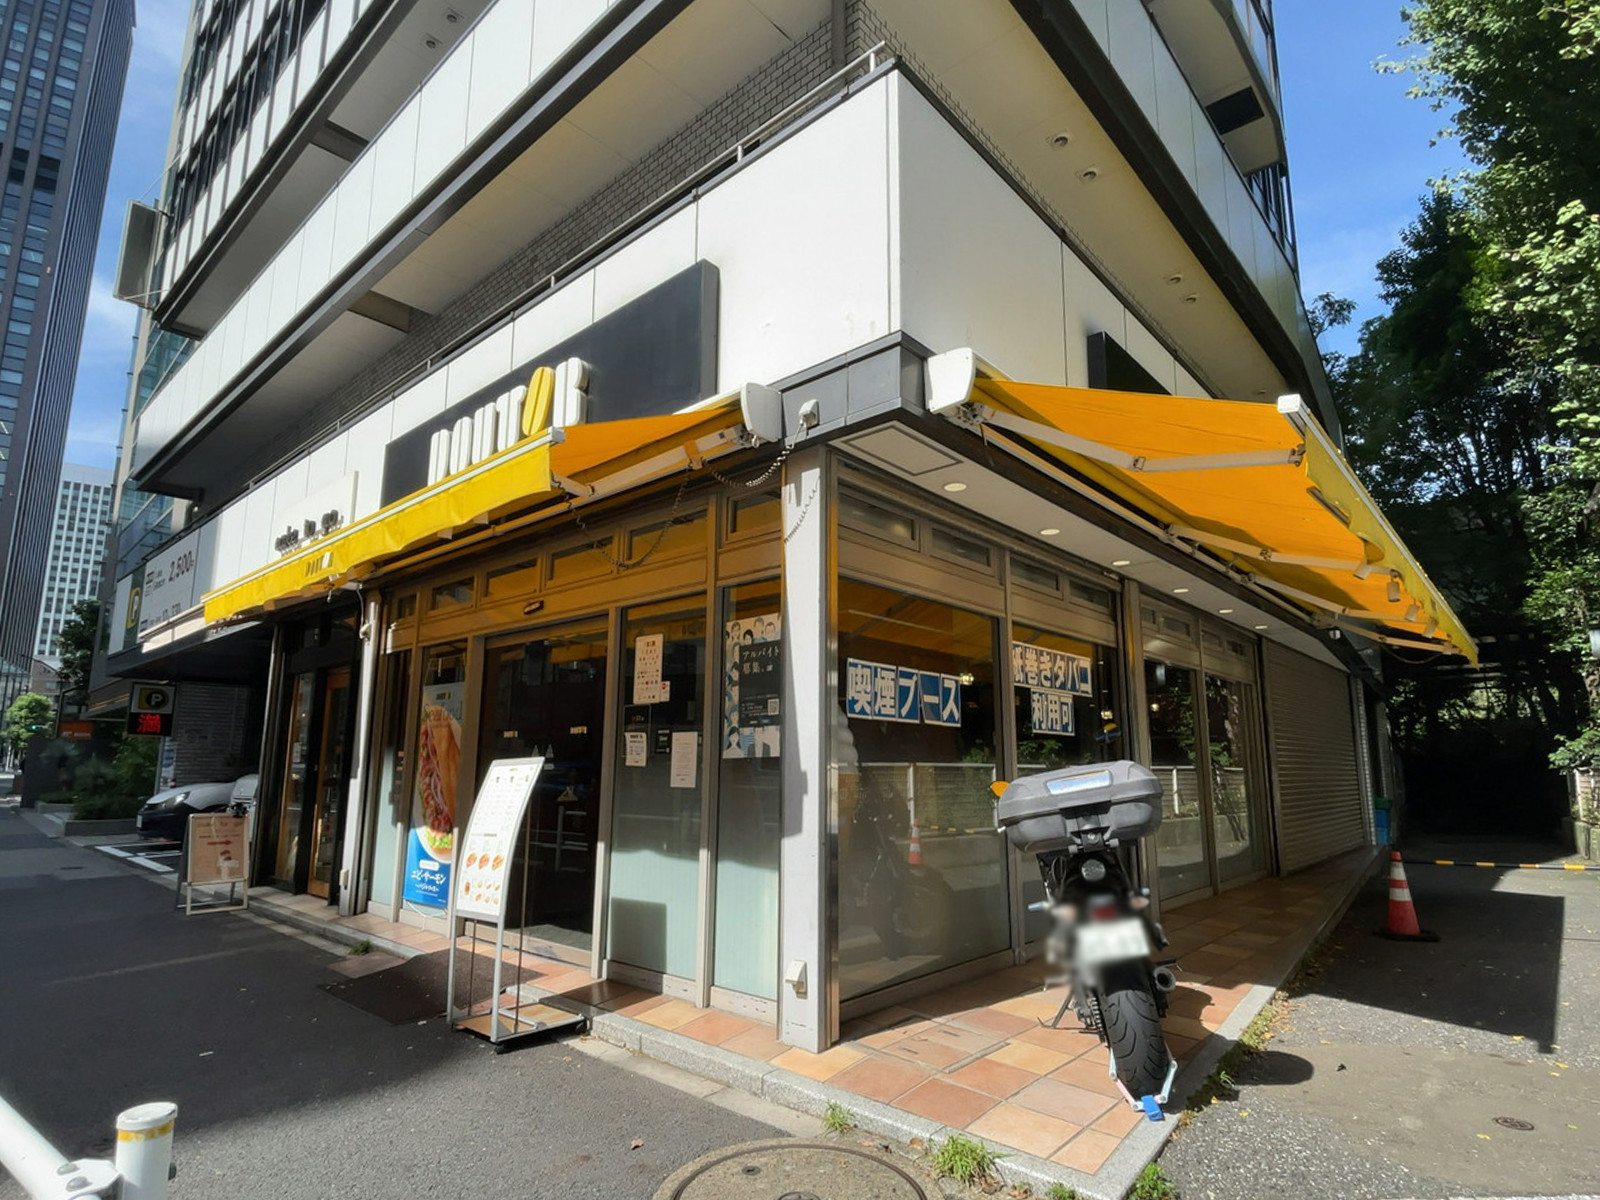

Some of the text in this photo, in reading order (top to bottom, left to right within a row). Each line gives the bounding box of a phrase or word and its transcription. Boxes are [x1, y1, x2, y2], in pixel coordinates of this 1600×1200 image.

[848, 664, 959, 721] 喫煙ブース
[1032, 693, 1071, 732] 利用可
